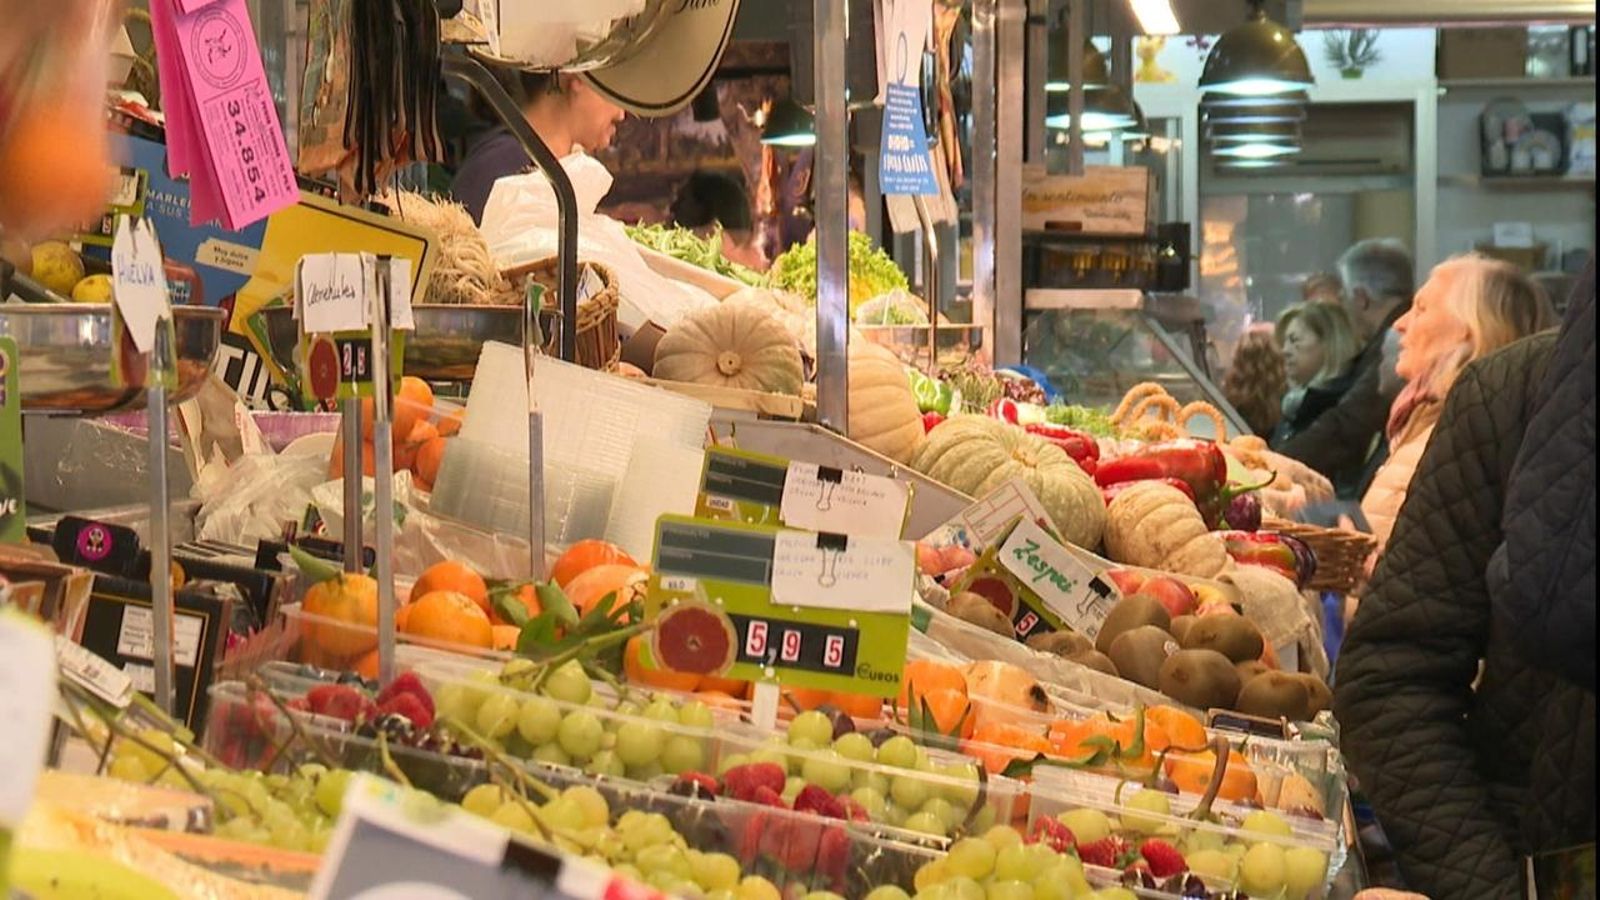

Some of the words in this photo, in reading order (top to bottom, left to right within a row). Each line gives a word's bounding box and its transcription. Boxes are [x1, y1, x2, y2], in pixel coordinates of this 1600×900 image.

[227, 99, 266, 203] 34.854
[117, 253, 155, 286] HUELVA
[1018, 614, 1037, 633] 5
